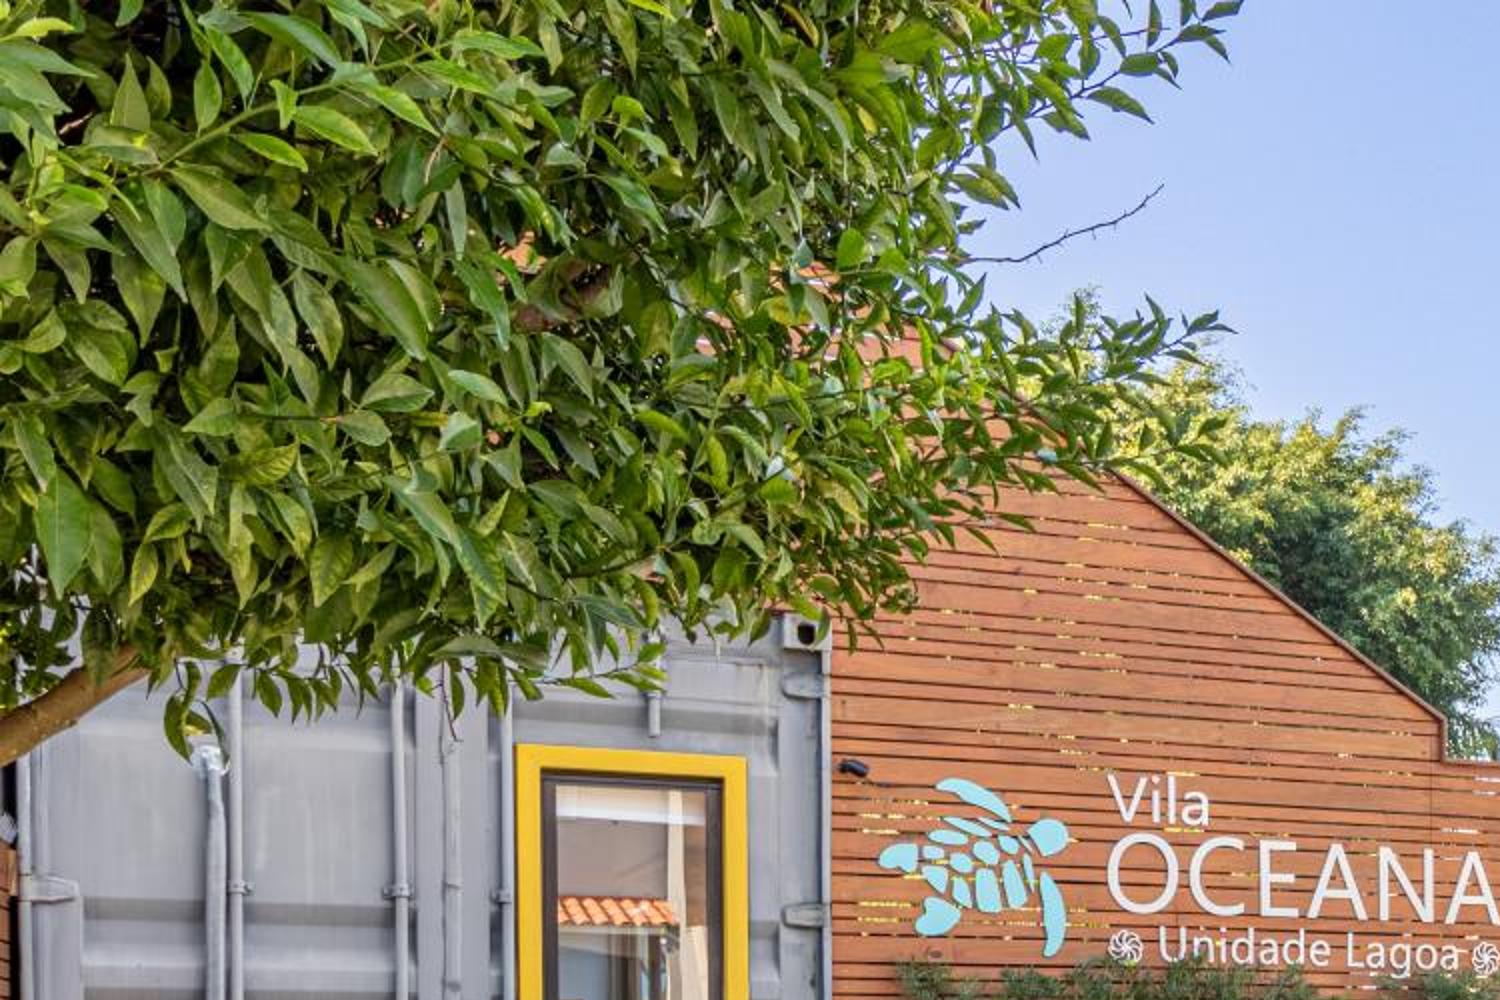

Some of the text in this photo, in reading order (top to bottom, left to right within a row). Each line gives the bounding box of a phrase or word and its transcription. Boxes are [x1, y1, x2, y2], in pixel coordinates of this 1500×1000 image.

[1107, 773, 1209, 825] Vila
[1159, 926, 1459, 978] Unidade Lagoa
